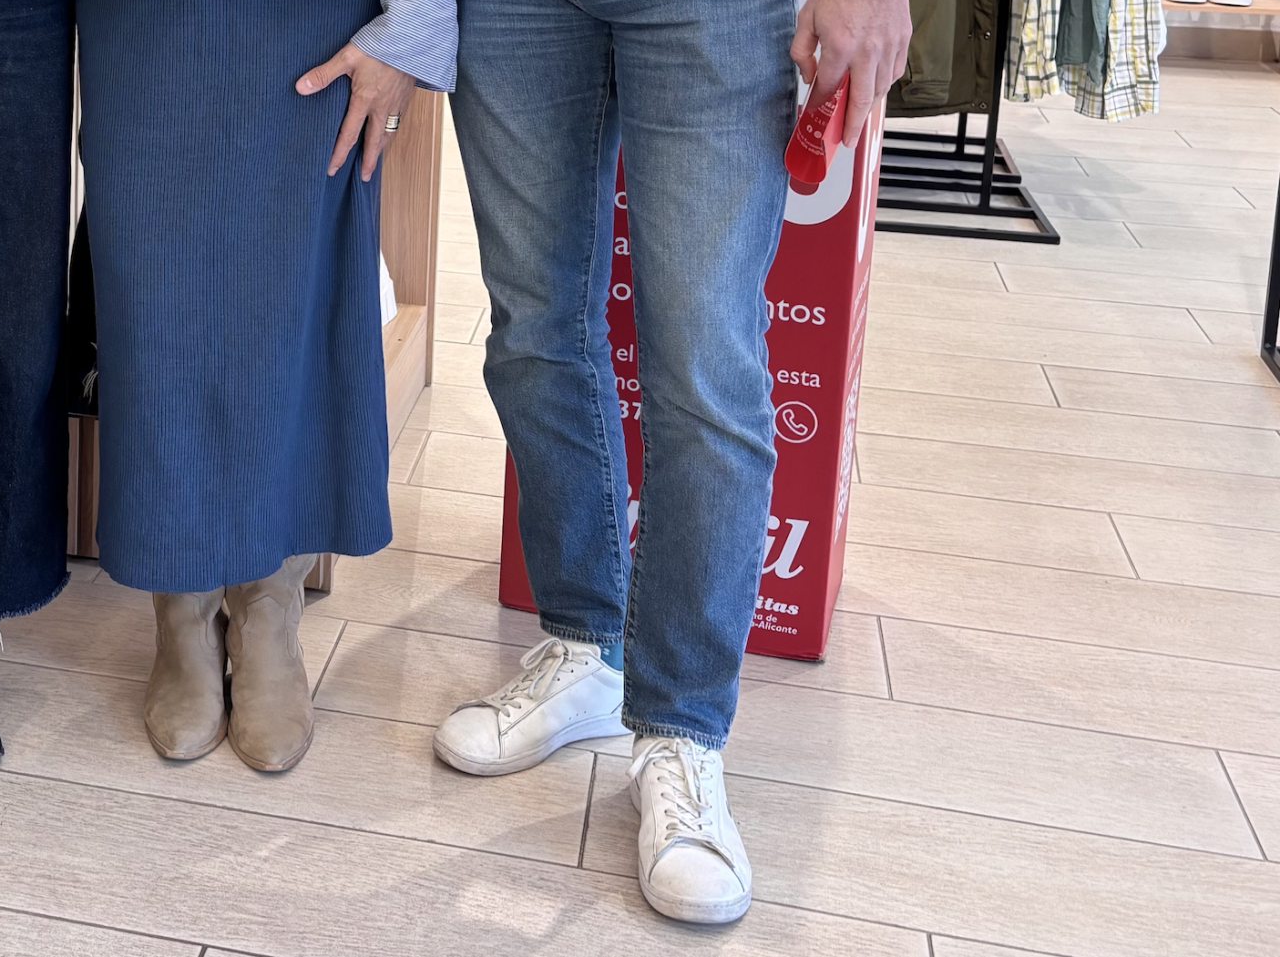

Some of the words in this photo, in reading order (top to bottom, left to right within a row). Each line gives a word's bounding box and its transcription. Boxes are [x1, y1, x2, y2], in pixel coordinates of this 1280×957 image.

[616, 344, 634, 362] el
[777, 369, 821, 388] esta
[766, 614, 778, 623] de
